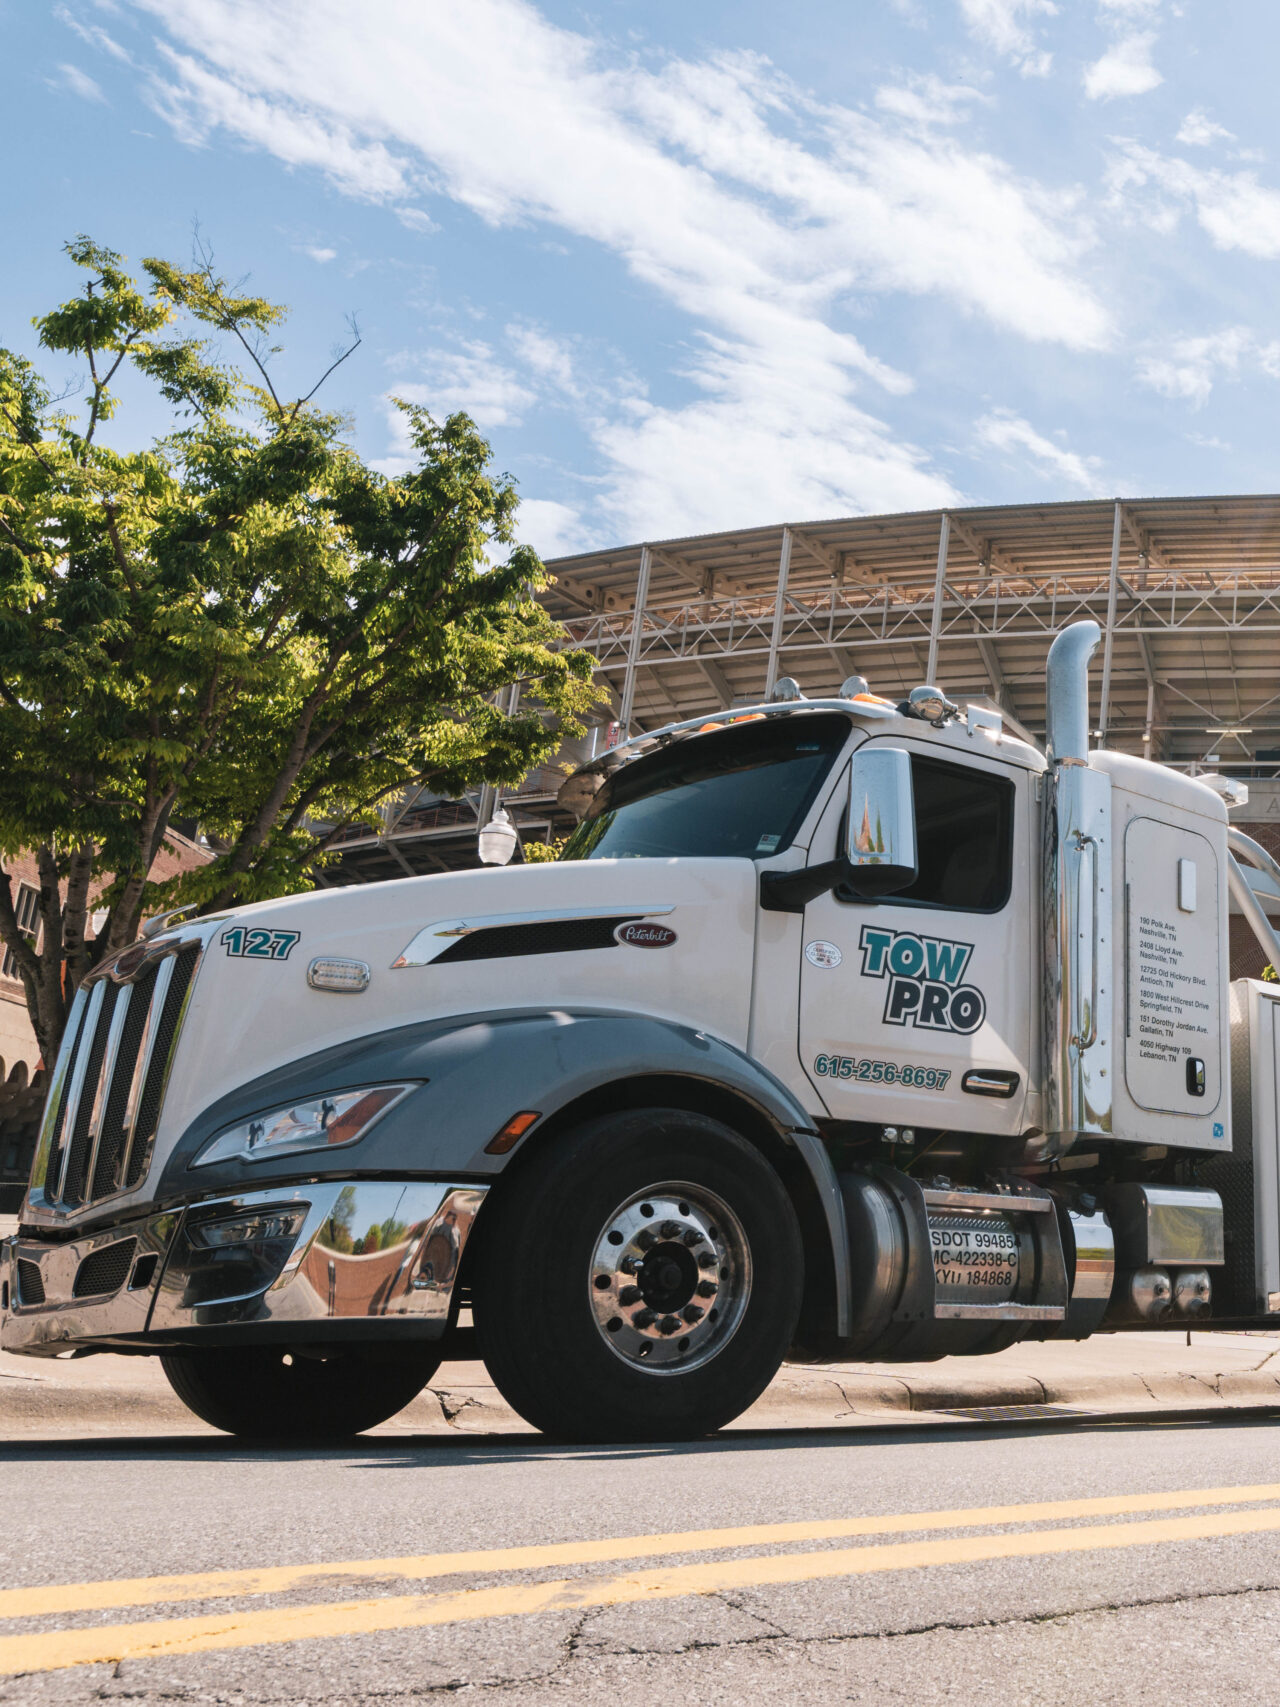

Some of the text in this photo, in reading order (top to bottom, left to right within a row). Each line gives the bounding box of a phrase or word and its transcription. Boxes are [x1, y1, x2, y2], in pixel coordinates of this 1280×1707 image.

[1140, 917, 1177, 932] 190 Polk Ave.
[626, 926, 672, 940] Peterbilt
[1140, 927, 1177, 941] Nashville, TN
[221, 927, 300, 959] 127
[1140, 940, 1184, 957] 2408 Lloyd Ave.
[860, 926, 973, 987] TOW
[1140, 951, 1178, 965] Nashville, TN
[1140, 965, 1207, 986] 12725 Old Hickory Blvd.
[1140, 975, 1174, 989] Antioch, TN
[884, 976, 985, 1034] PRO
[1140, 989, 1210, 1010] 1800 West Hillcrest Drive
[1140, 999, 1182, 1015] Springfield, TN
[1140, 1015, 1209, 1034] 151 Dorothy Jordan Ave.
[1140, 1025, 1174, 1038] Gallatin, TN
[1140, 1039, 1192, 1055] 4050 Highway 109
[1140, 1050, 1177, 1063] Lebanon, TN
[814, 1054, 951, 1090] 615-256-8697
[931, 1231, 970, 1247] SDOT
[967, 1270, 1012, 1286] 184868
